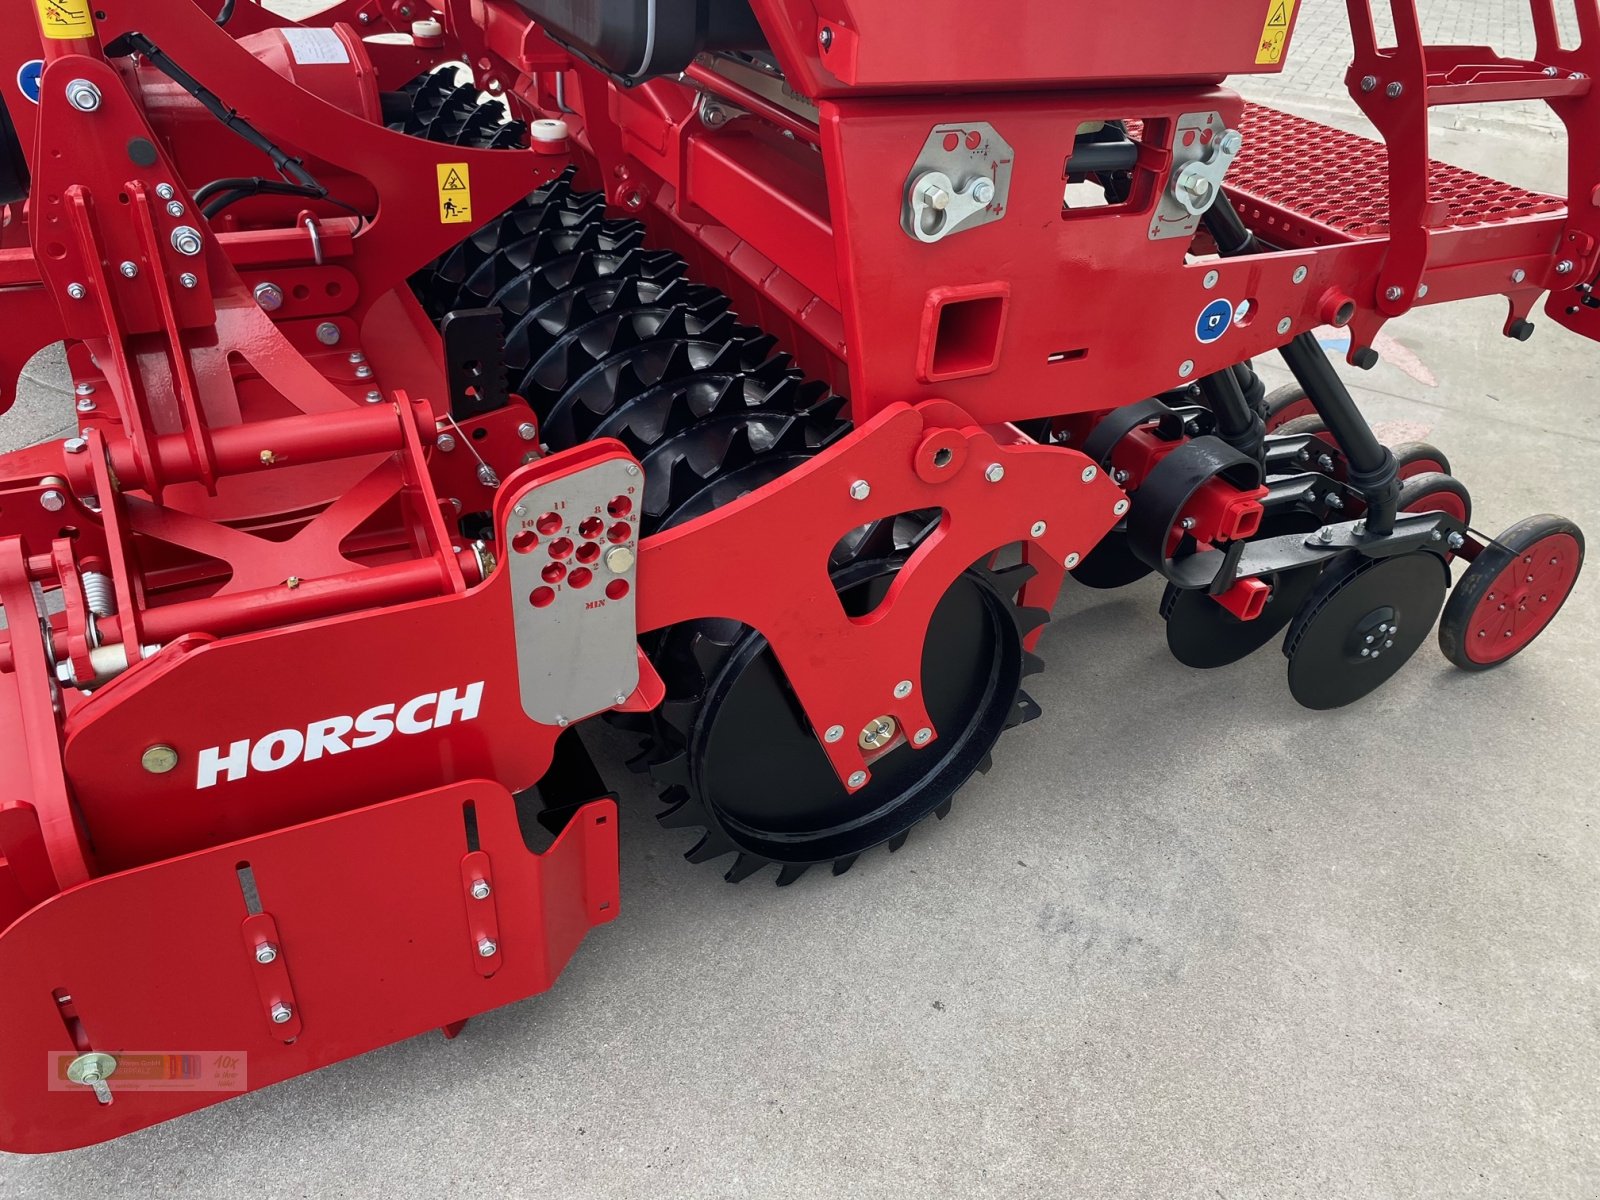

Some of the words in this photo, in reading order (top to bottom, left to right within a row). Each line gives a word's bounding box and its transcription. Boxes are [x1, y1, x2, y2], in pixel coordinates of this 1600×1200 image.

[627, 486, 635, 494] 9
[553, 501, 566, 510] 11
[594, 506, 602, 514] 8
[629, 514, 637, 522] 6
[521, 519, 534, 529] 10
[564, 526, 571, 534] 7
[599, 537, 606, 545] 5
[566, 558, 573, 566] 4
[592, 563, 600, 571] 2
[585, 599, 606, 610] MIN
[196, 680, 485, 790] HORSCH
